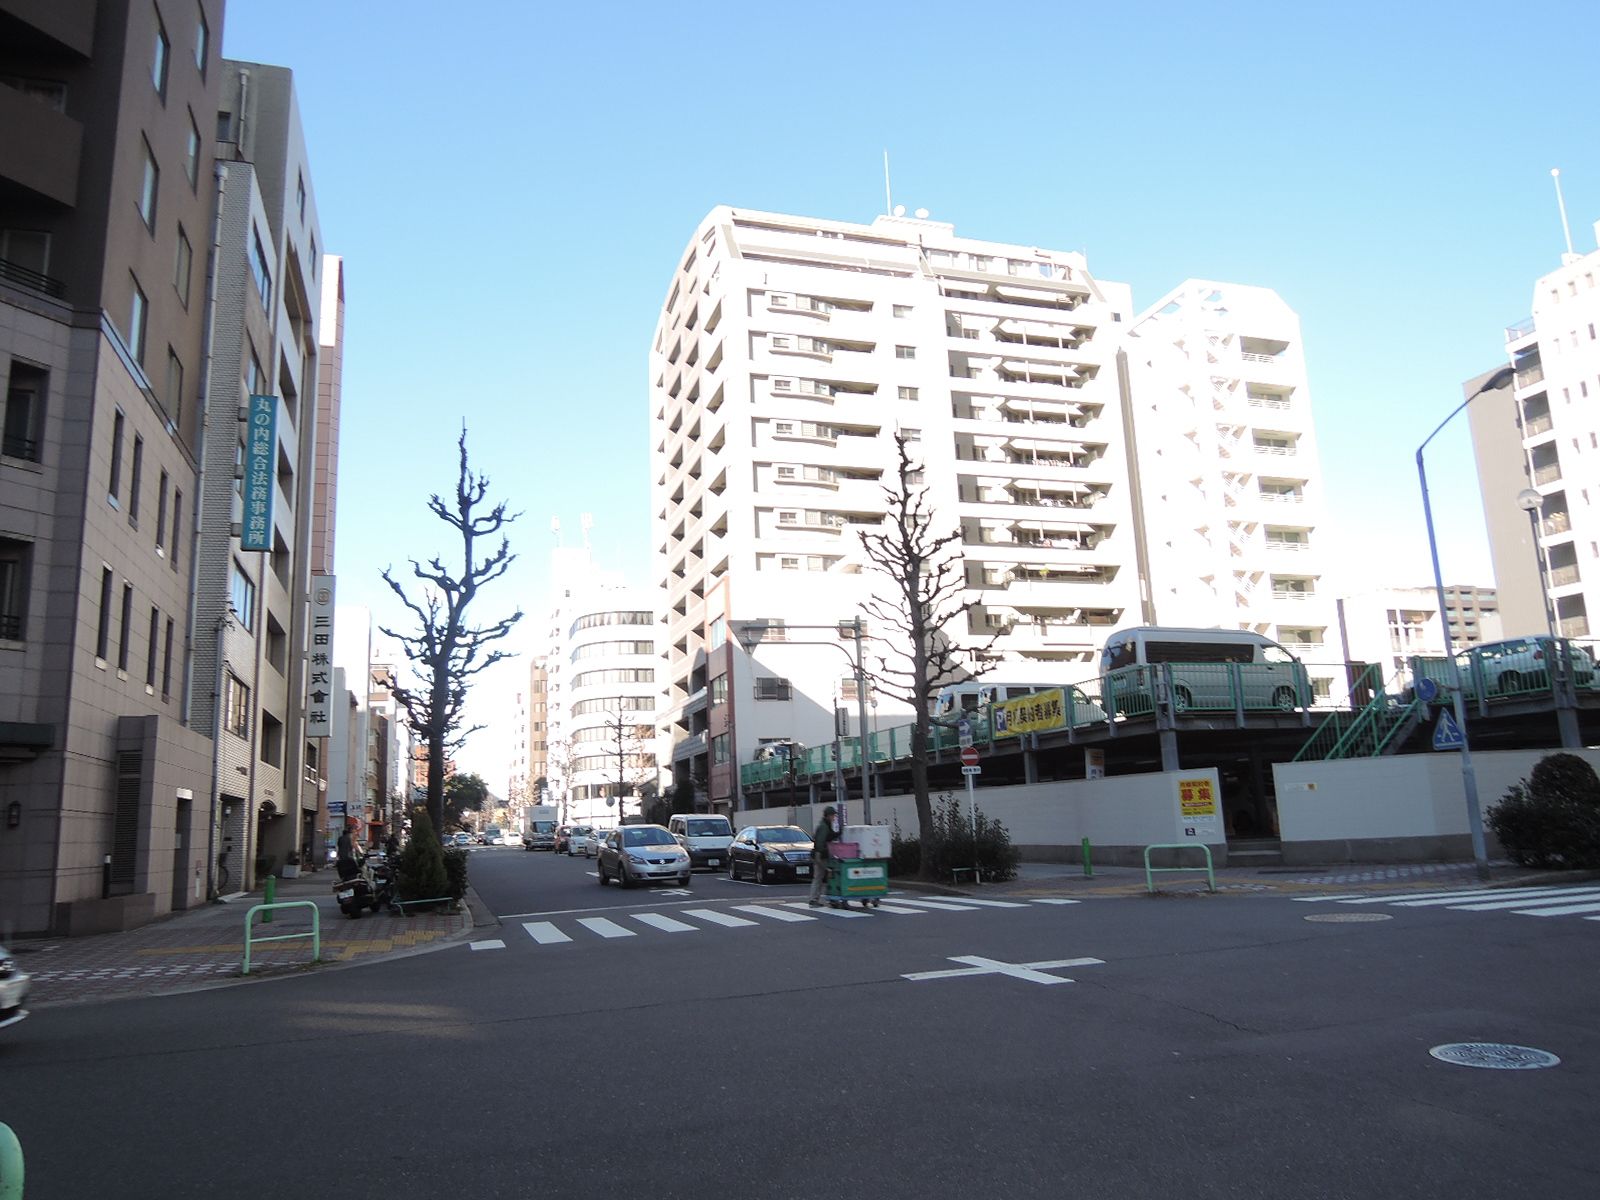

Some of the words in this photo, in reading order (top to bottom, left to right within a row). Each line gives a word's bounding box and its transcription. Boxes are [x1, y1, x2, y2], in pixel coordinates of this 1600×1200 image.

[248, 398, 271, 545] 丸の内総合法務事務所
